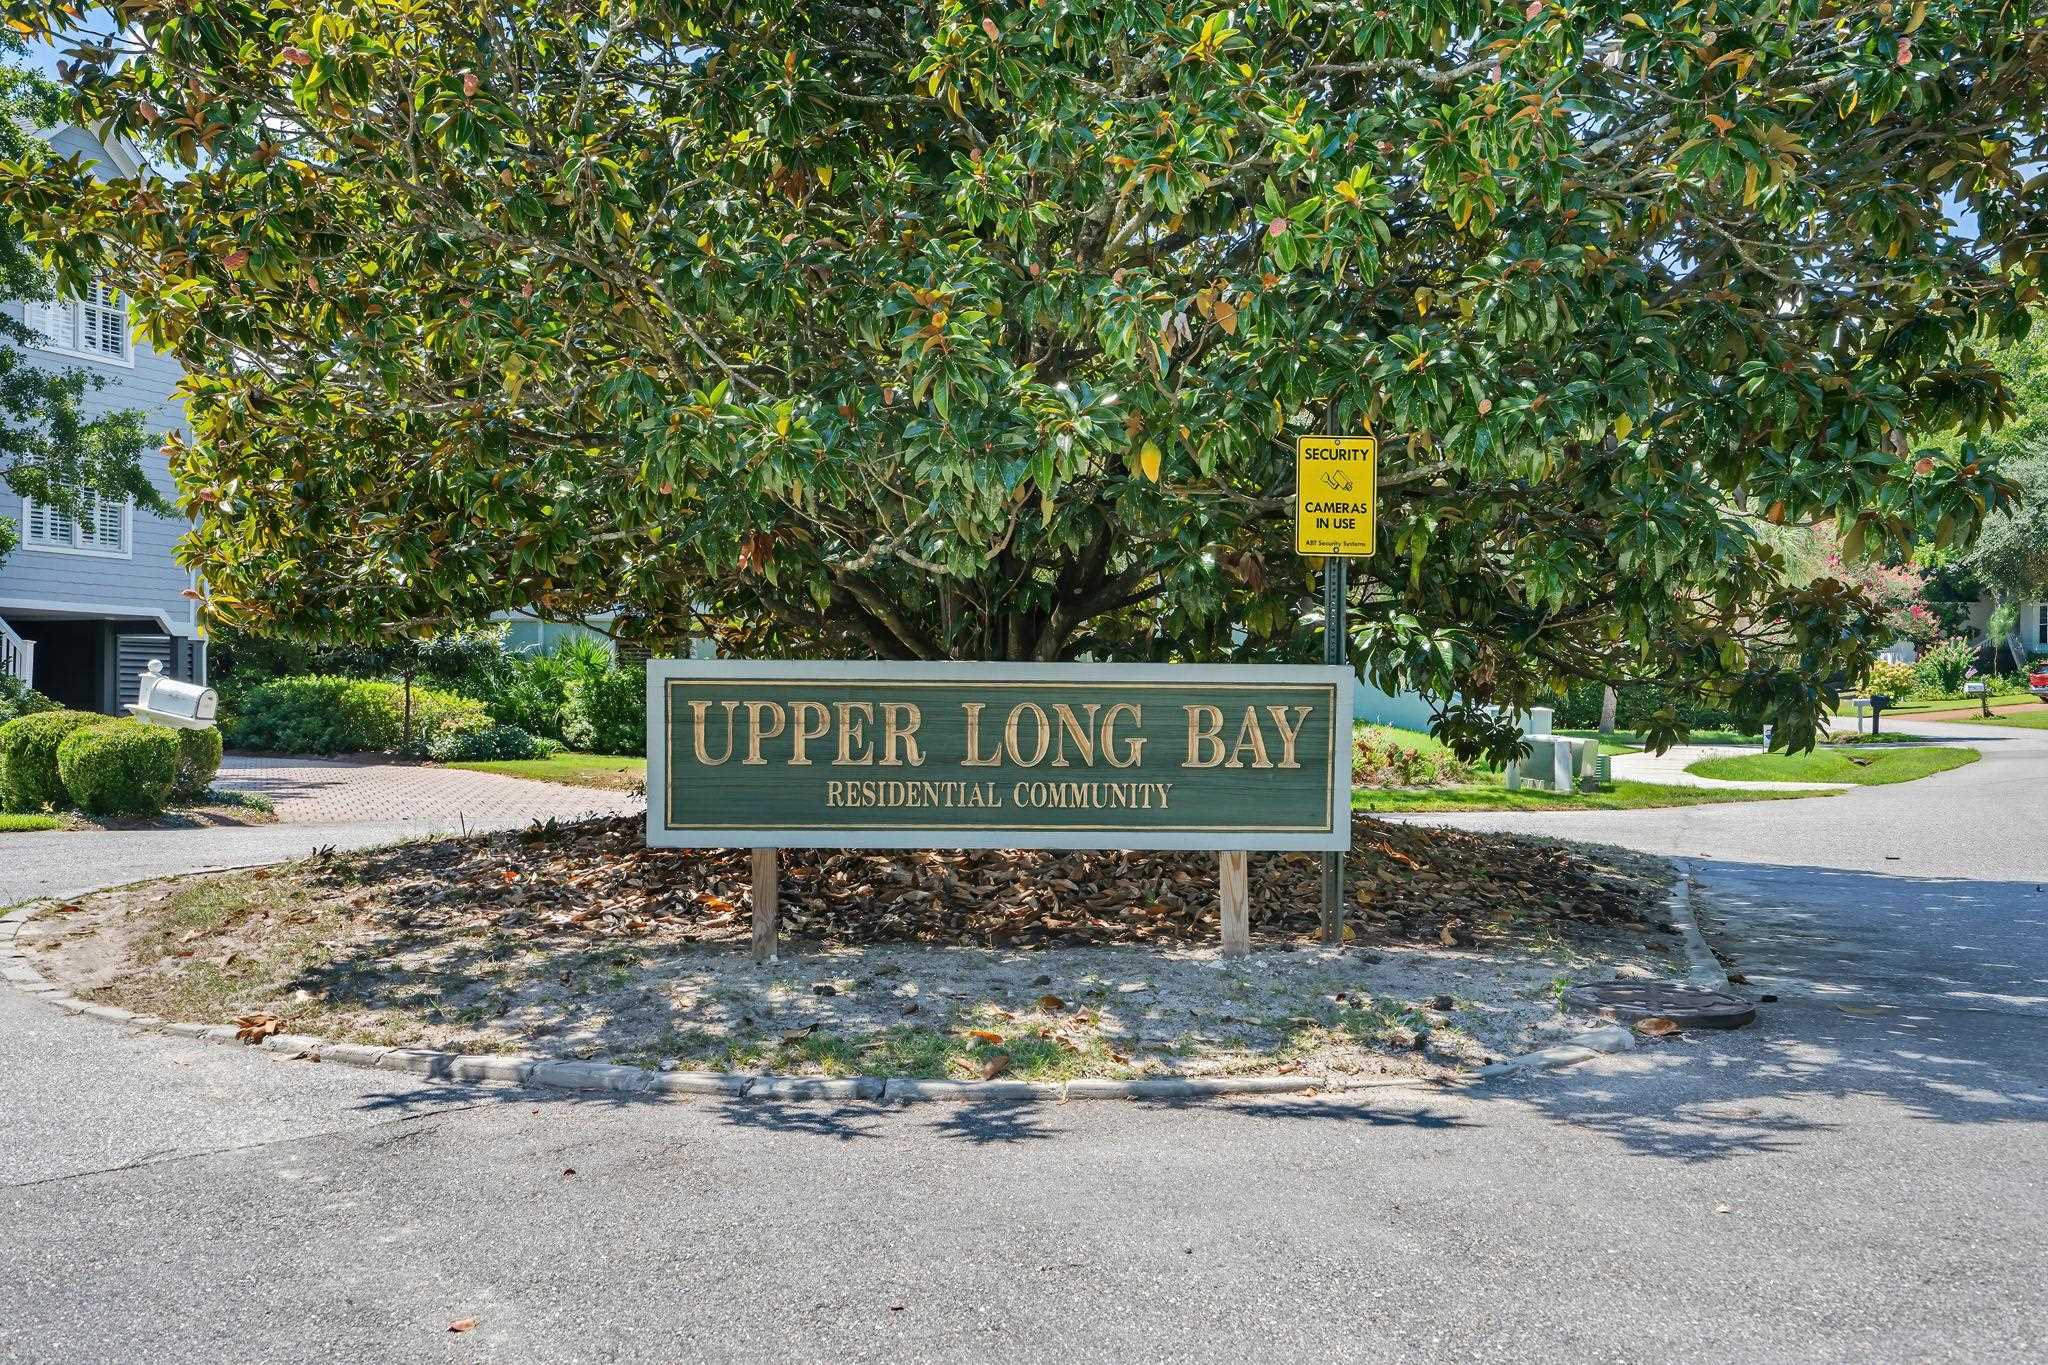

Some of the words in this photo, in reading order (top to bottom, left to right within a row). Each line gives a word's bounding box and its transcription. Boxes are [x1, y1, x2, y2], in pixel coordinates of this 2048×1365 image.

[1305, 448, 1369, 461] SECURITY
[1305, 502, 1367, 514] CAMERAS
[1316, 518, 1329, 529] IN
[1333, 518, 1356, 529] USE
[688, 699, 927, 767] UPPER
[961, 702, 1147, 769] LONG
[1181, 704, 1314, 769] BAY
[826, 780, 1002, 809] RESIDENTIAL
[1013, 781, 1173, 810] COMMUNITY
